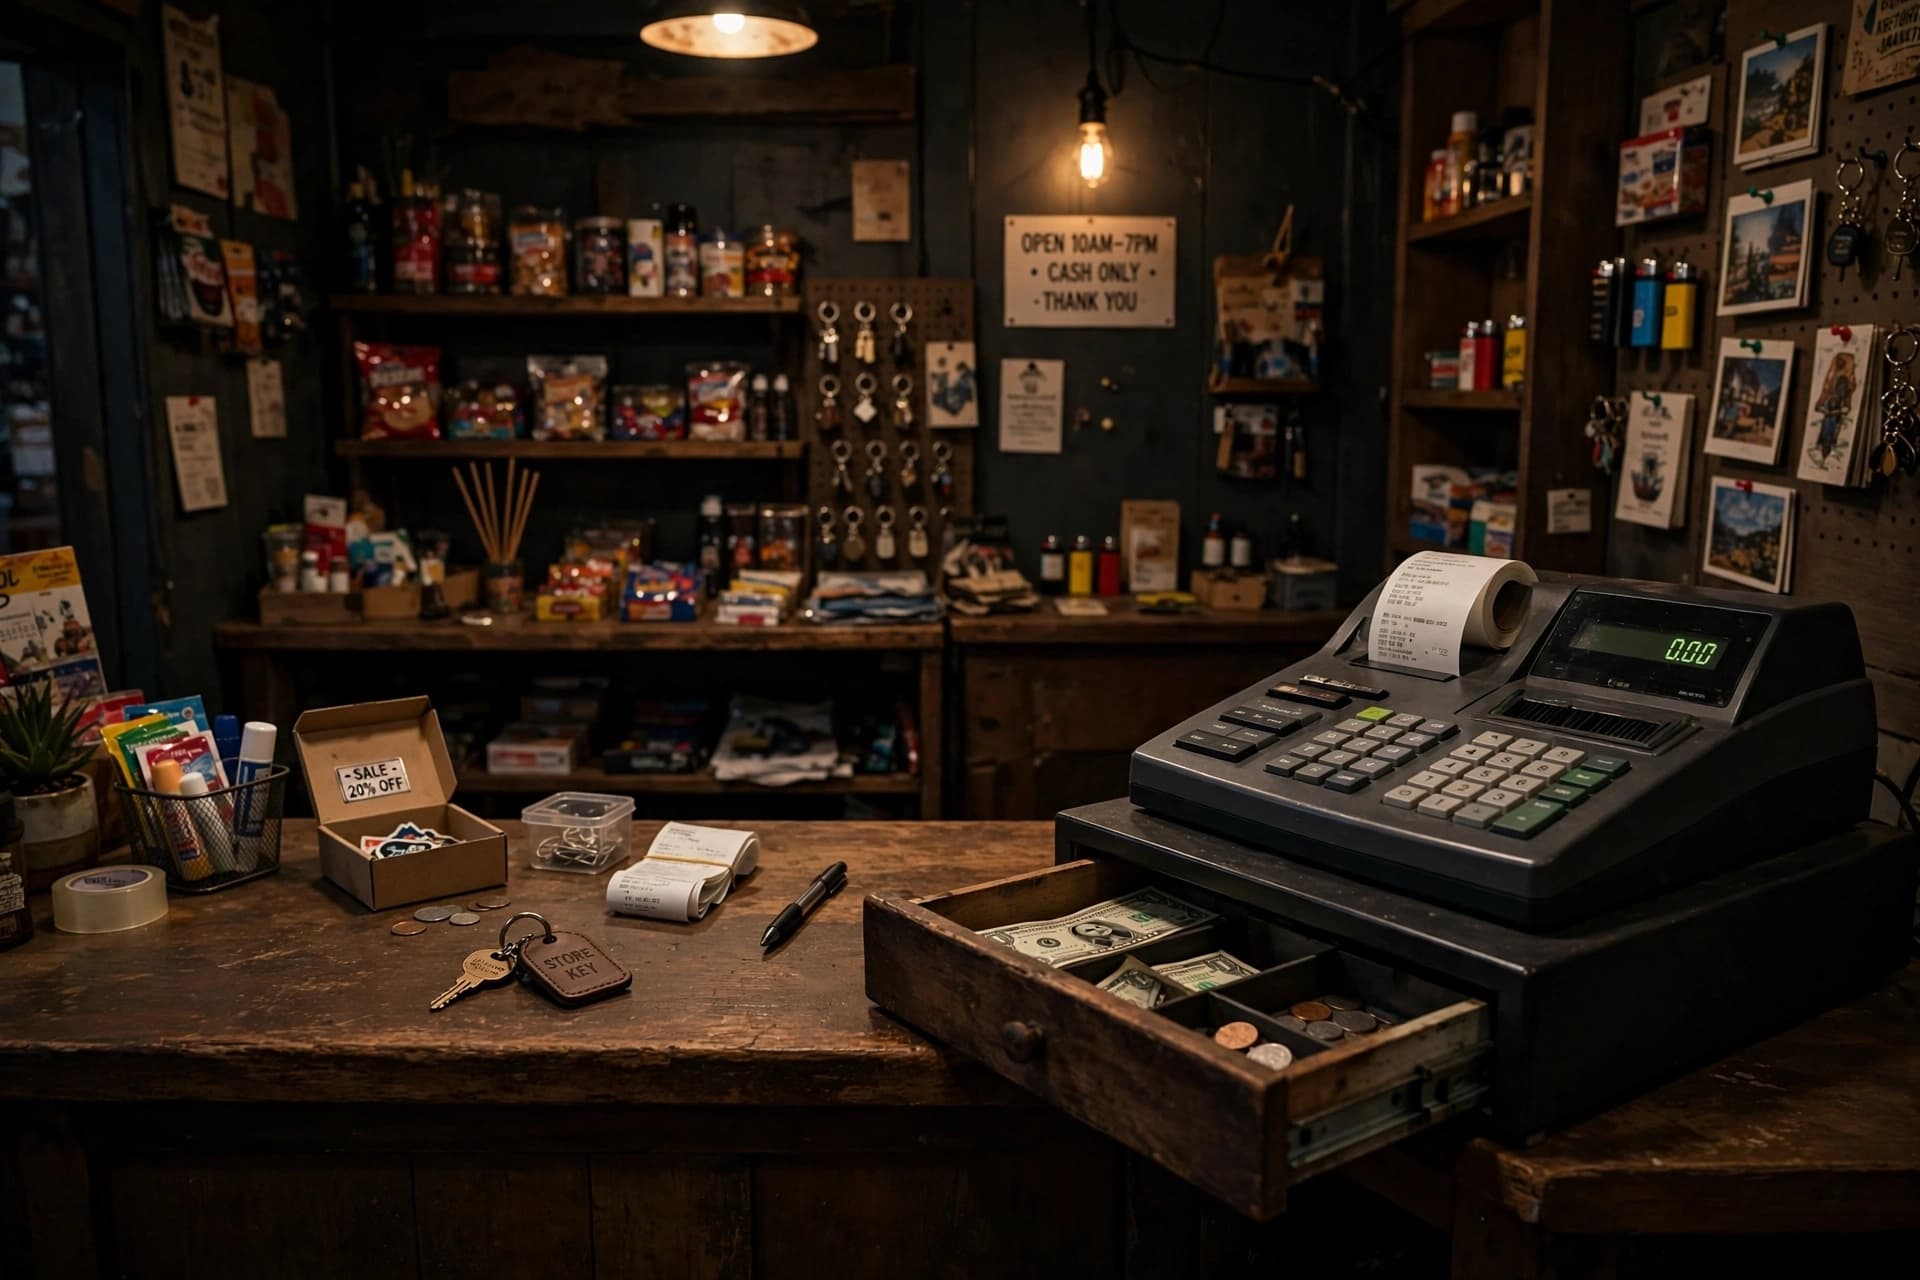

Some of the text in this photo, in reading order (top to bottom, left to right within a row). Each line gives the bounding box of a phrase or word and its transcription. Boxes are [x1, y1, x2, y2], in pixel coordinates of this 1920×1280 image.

[1020, 232, 1159, 253] OPEN 10AM-7PM
[1047, 261, 1142, 283] CASH ONLY
[1042, 291, 1139, 312] THANK YOU
[1664, 637, 1718, 665] 0.00
[353, 763, 389, 781] SALE
[347, 776, 404, 799] 20% OFF
[543, 947, 596, 970] STORE
[565, 961, 600, 981] KEY
